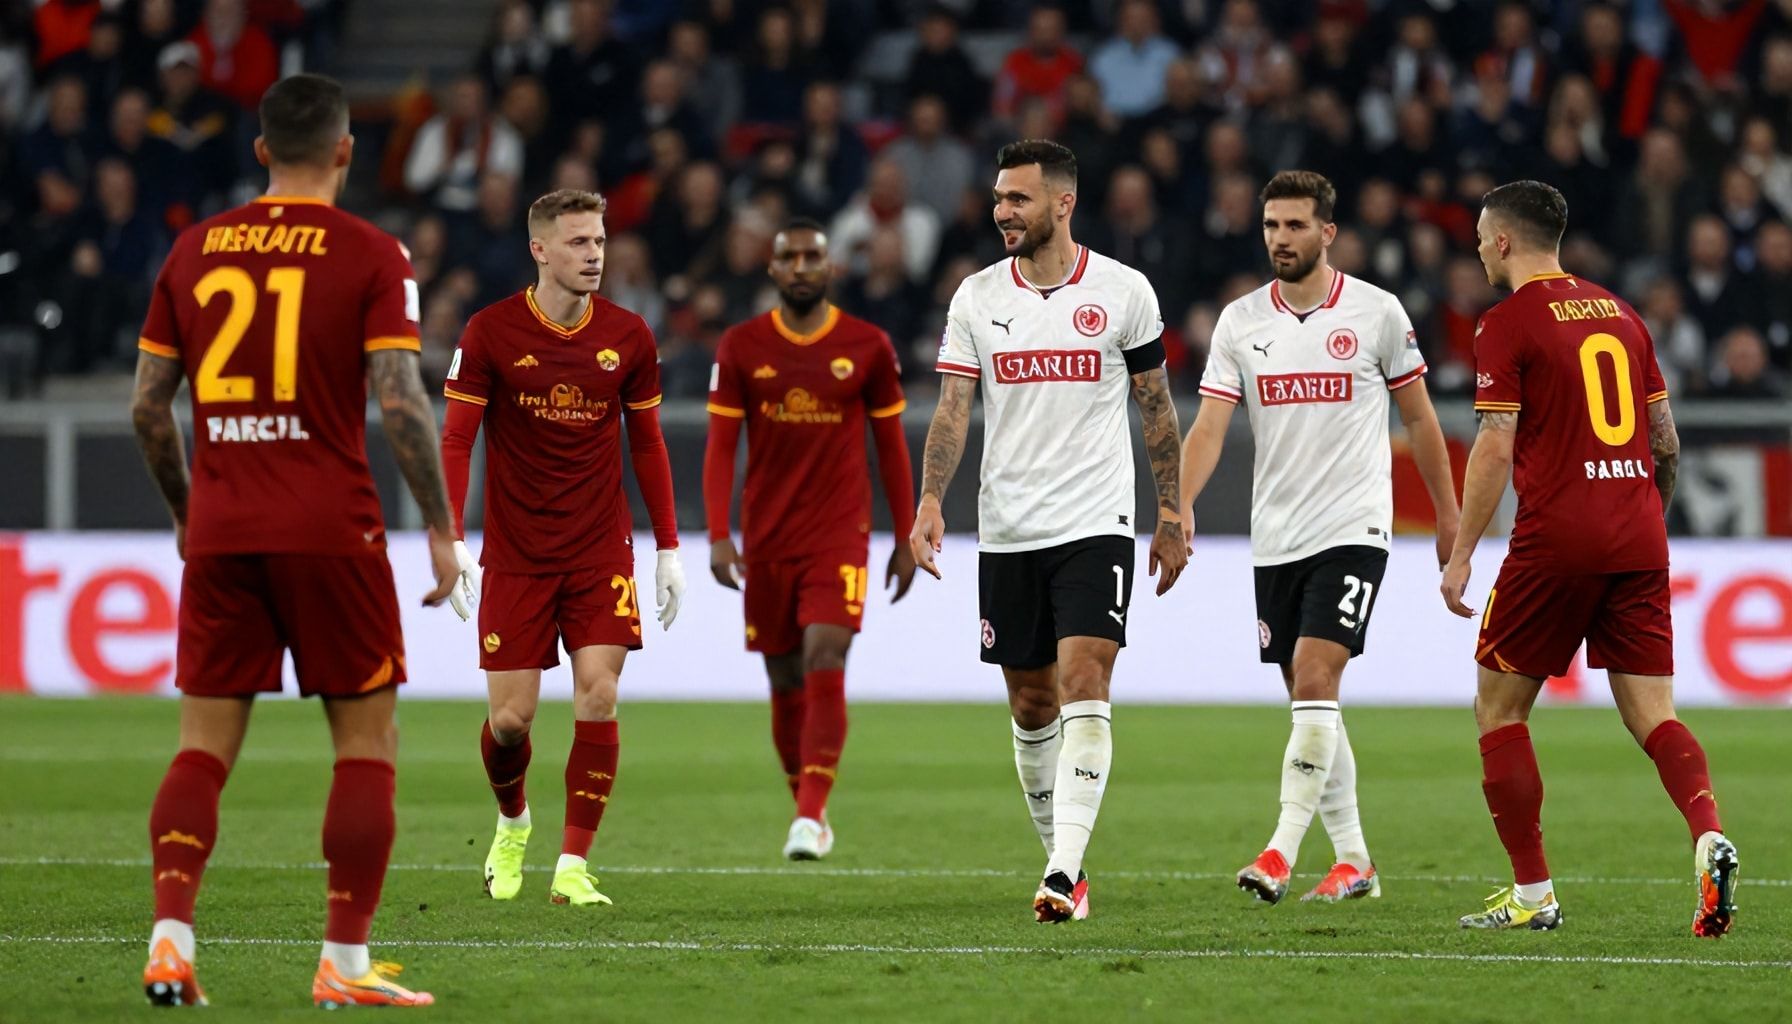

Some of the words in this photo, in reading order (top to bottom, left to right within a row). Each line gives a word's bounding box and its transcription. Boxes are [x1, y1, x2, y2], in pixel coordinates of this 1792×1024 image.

[193, 266, 305, 403] 21
[1579, 333, 1635, 446] 0
[1338, 575, 1373, 622] 21
